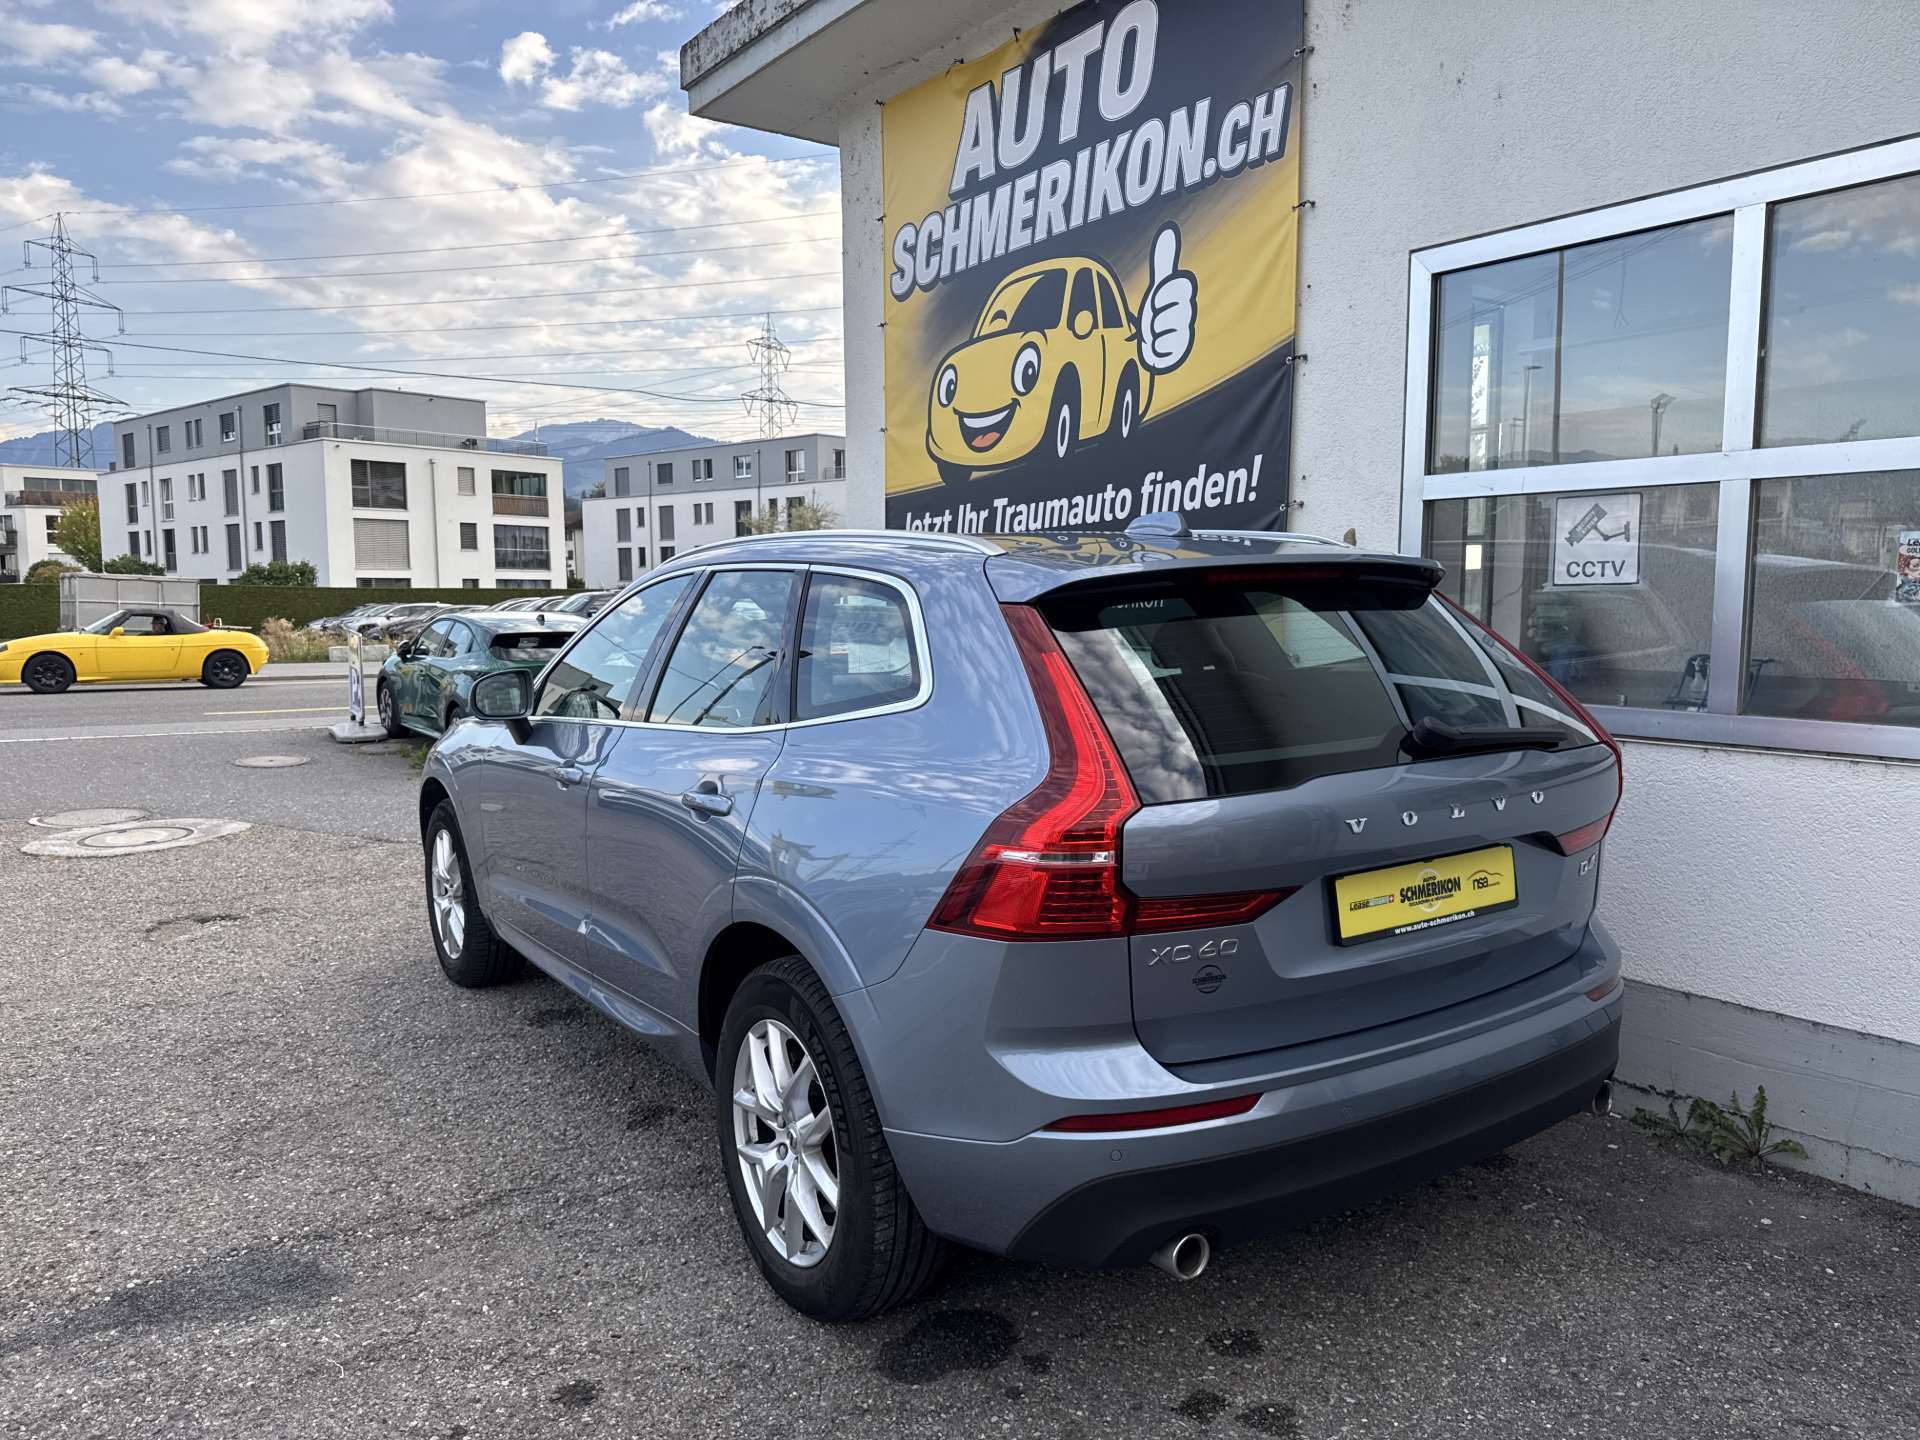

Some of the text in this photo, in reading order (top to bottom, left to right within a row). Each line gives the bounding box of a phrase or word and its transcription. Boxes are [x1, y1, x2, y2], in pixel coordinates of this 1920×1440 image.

[949, 0, 1159, 193] AUTO
[890, 83, 1291, 297] SCHMERIKON.CH
[957, 503, 989, 534] Ihr
[993, 483, 1132, 534] Traumauto
[1141, 454, 1263, 514] finden!
[1566, 560, 1626, 578] CCTV
[1344, 790, 1545, 834] VOLVO
[1400, 877, 1461, 904] SCHMERIKON
[1472, 876, 1489, 891] nsa
[1394, 910, 1475, 935] www.auto-schmerikon.ch
[1148, 938, 1239, 966] XC60
[810, 1039, 852, 1154] MICHELIN
